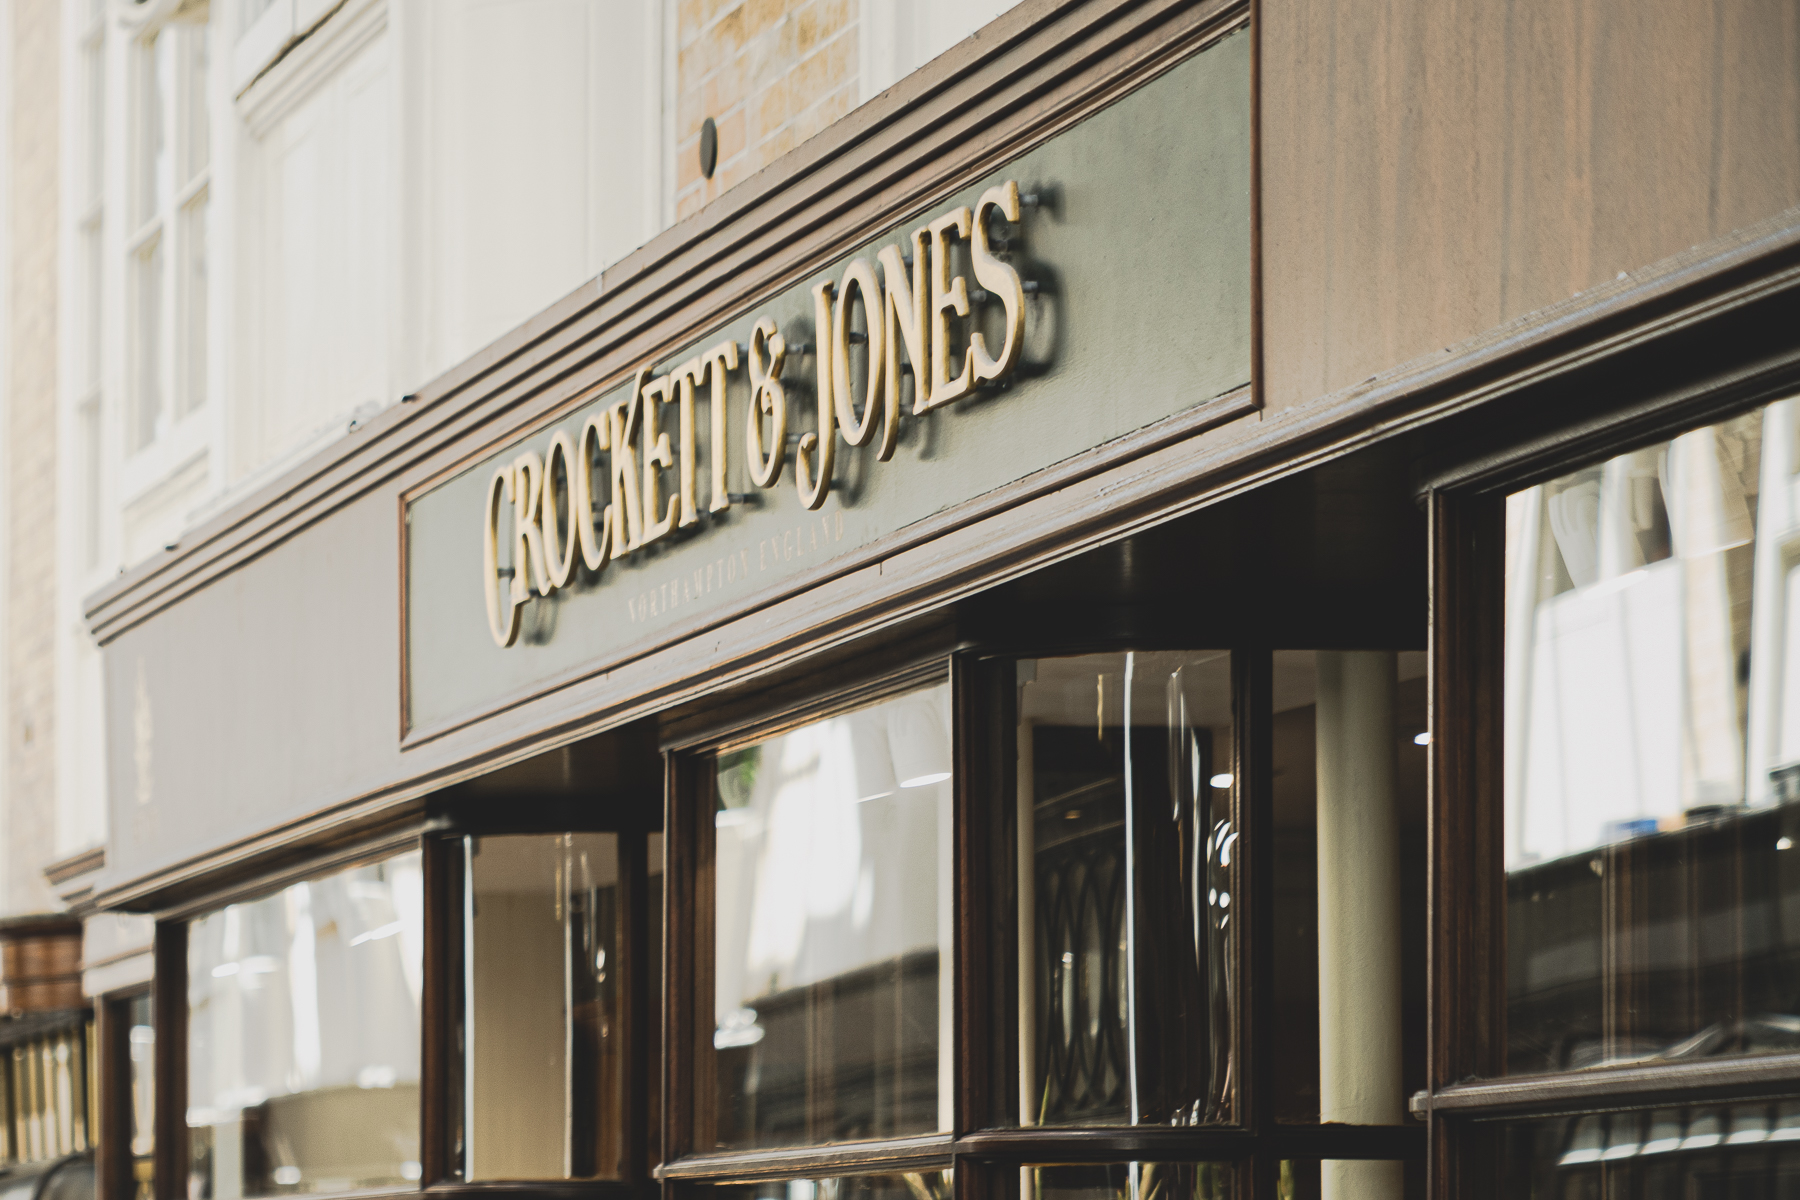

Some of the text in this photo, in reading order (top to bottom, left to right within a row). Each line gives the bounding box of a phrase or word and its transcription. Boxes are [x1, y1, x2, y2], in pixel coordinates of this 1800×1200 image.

[484, 180, 1026, 648] CROCKETT & JONES
[628, 510, 844, 623] NORTHAMPTON ENGLAND
